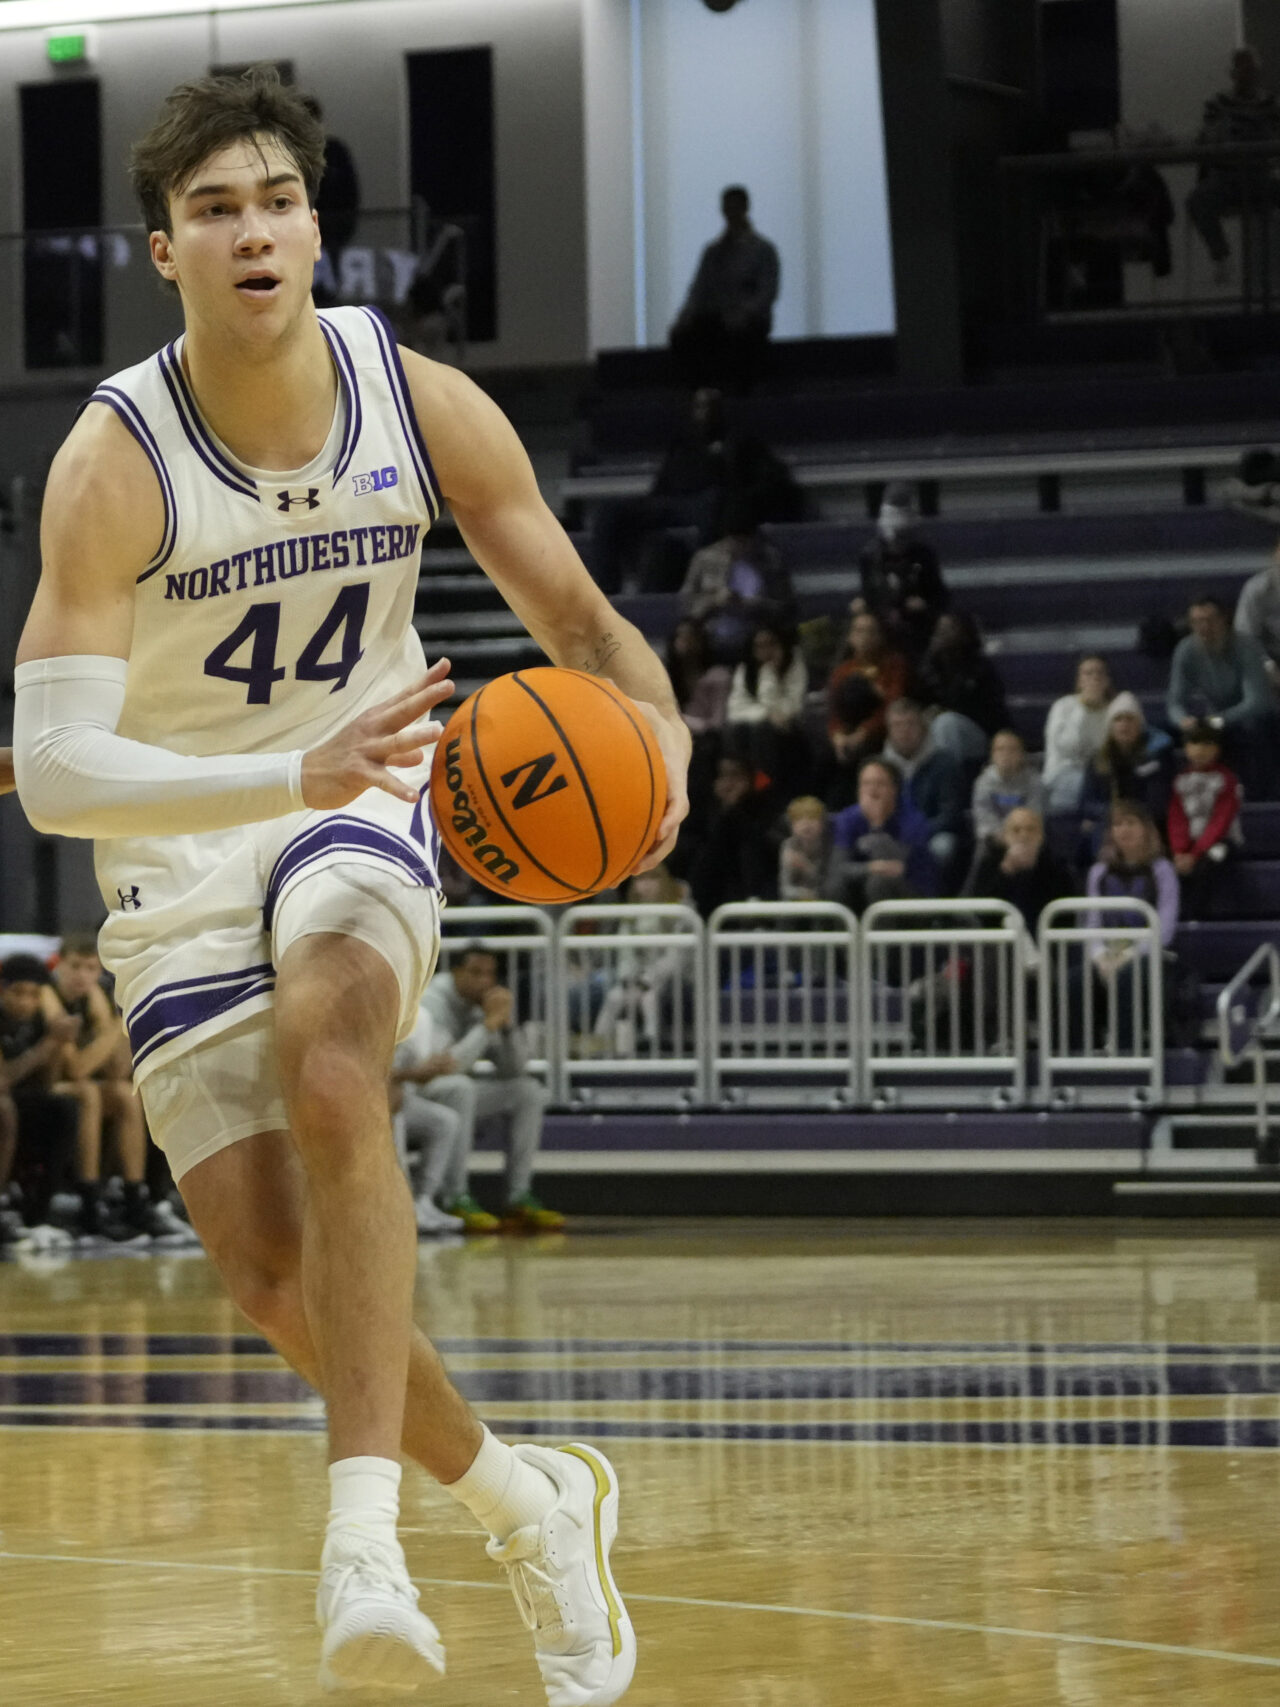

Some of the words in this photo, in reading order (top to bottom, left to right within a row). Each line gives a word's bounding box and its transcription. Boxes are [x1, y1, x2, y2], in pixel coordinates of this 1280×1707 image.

[164, 523, 421, 601] NORTHWESTERN
[204, 581, 370, 704] 44
[445, 736, 520, 885] Wilson
[500, 752, 568, 810] N
